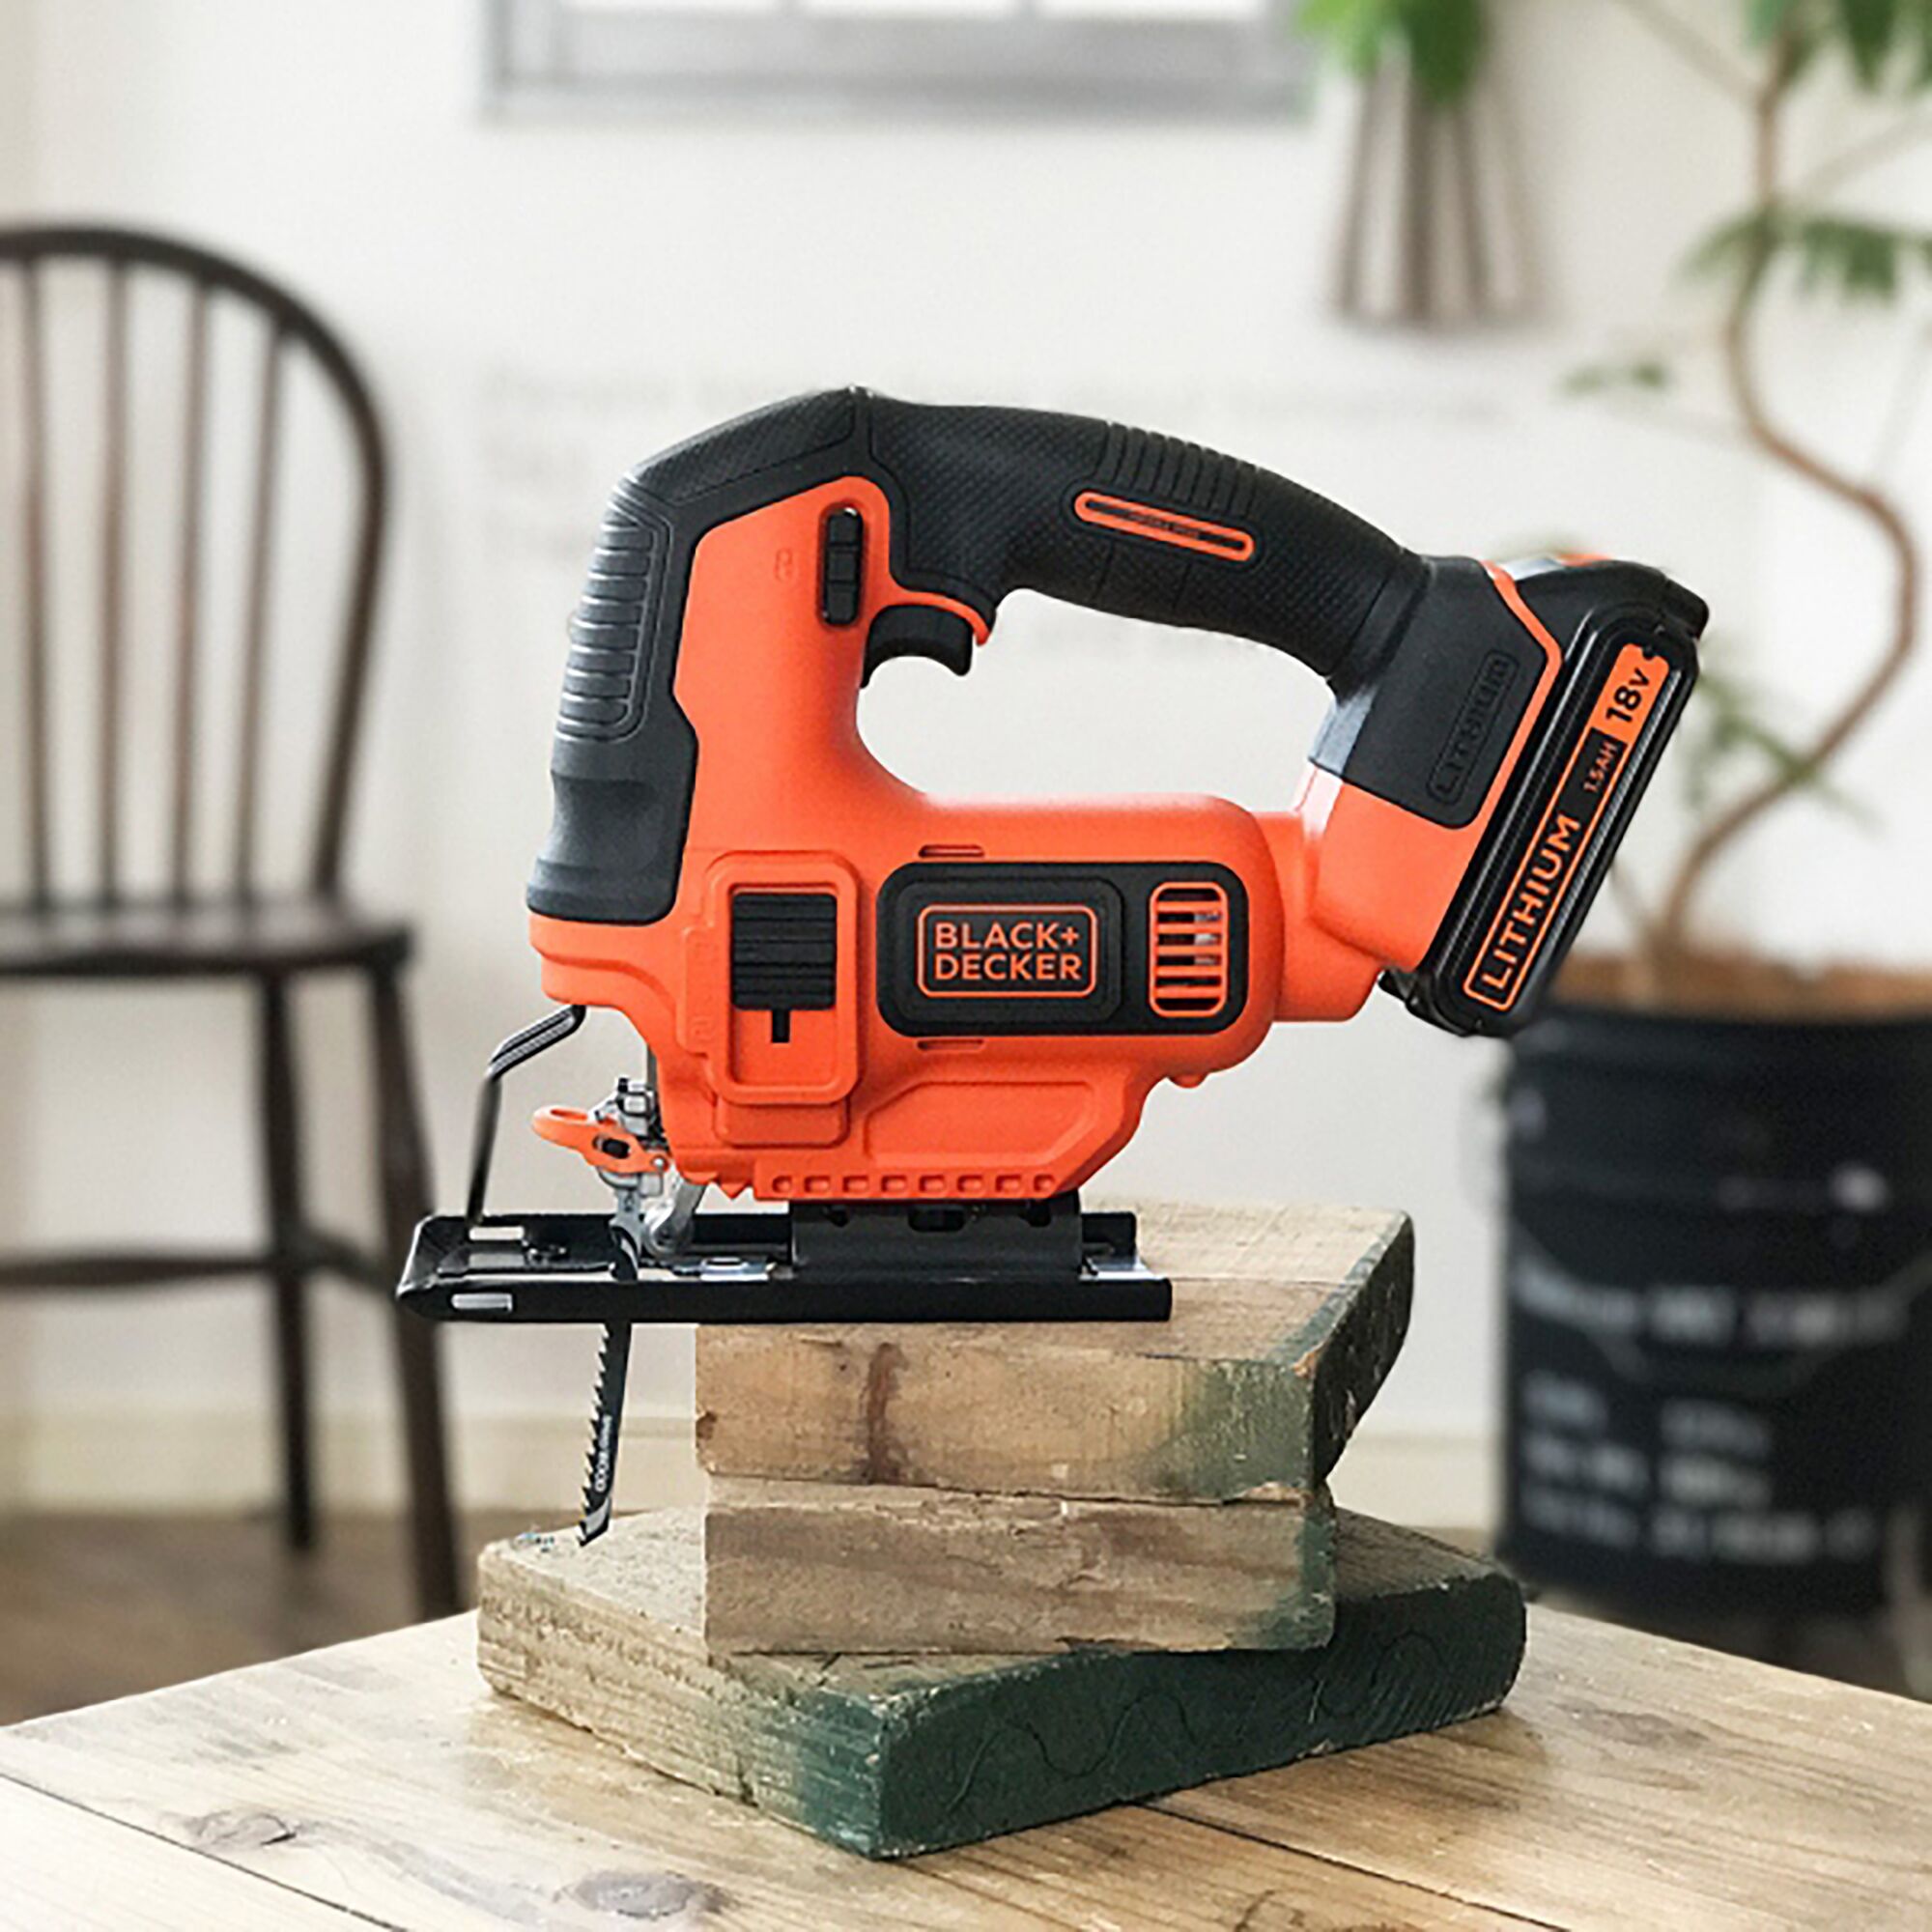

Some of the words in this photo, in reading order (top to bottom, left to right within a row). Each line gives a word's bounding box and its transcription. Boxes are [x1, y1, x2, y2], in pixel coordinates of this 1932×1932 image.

[1481, 810, 1580, 989] LITHIUM
[1582, 741, 1620, 793] 1.5AH
[933, 922, 1080, 950] BLACK+
[933, 952, 1083, 980] DECKER
